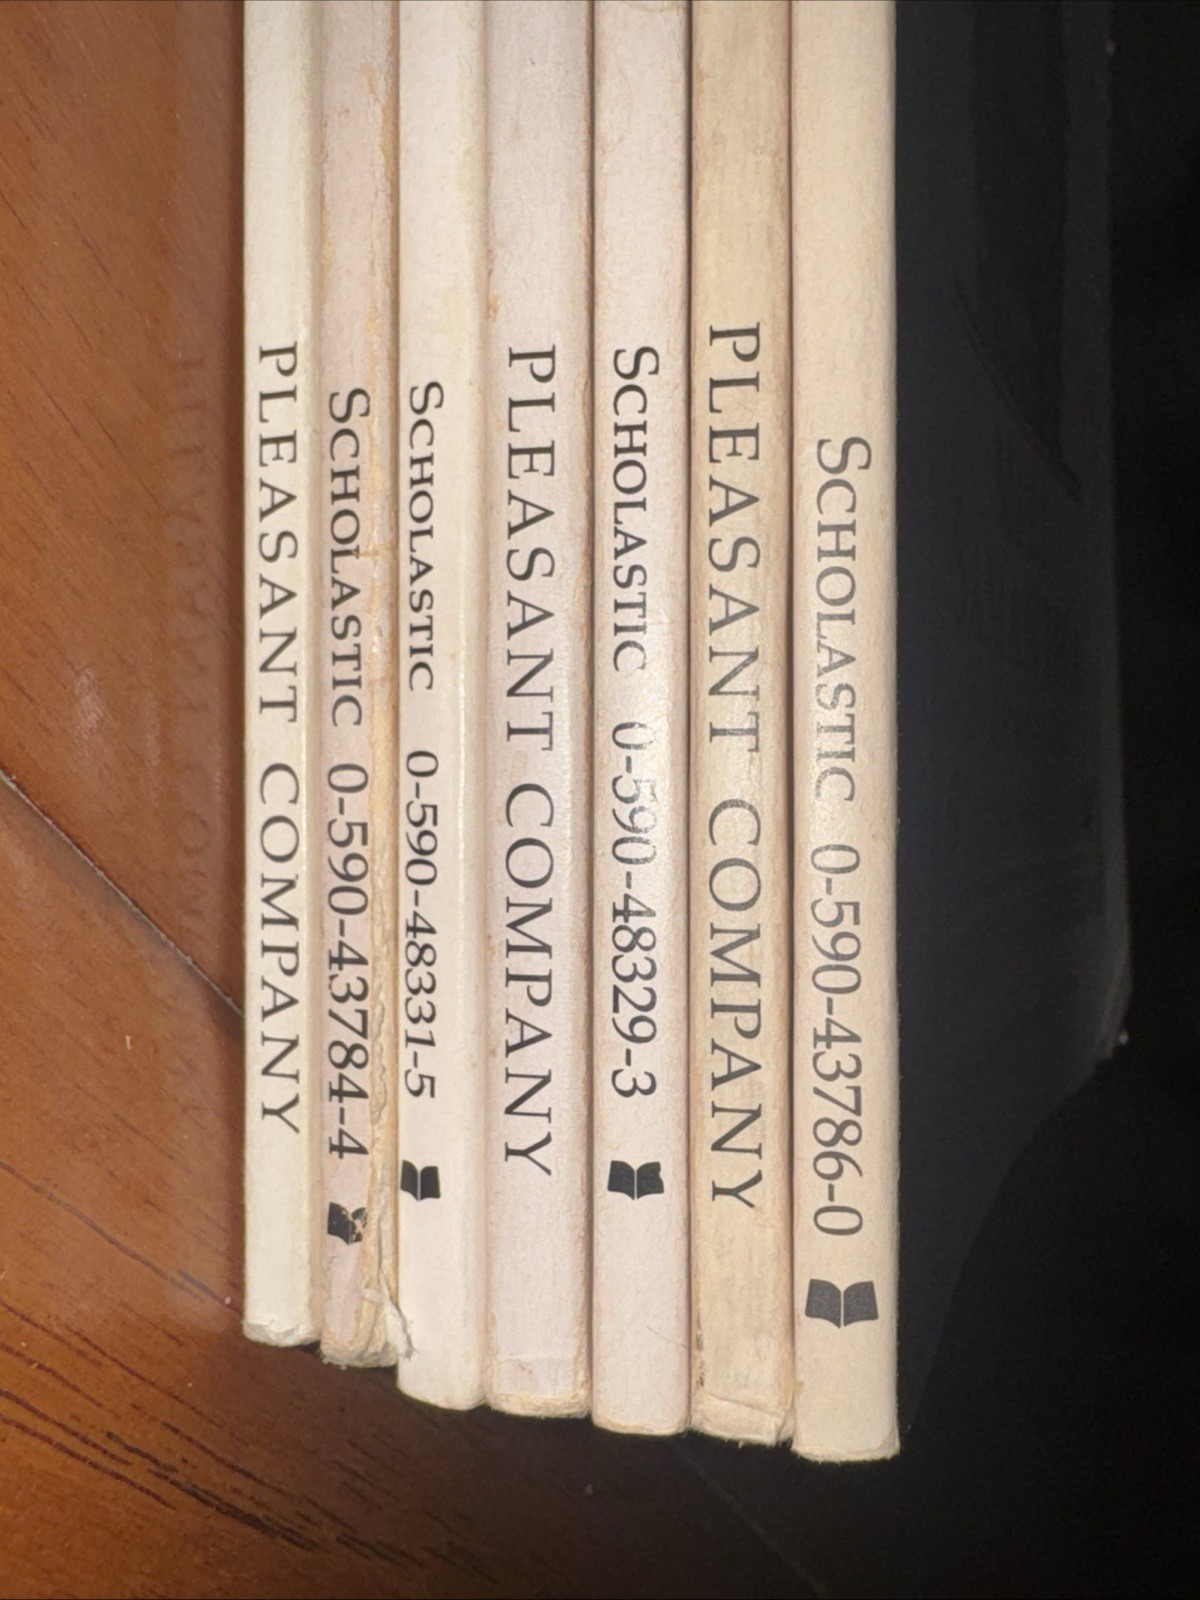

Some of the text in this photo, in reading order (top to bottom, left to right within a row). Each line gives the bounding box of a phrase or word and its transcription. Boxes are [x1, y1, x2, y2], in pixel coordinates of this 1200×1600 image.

[258, 342, 300, 1134] PLEASANT COMPANY
[327, 388, 371, 1159] SCHOLASTIC 0-590-43784-4
[404, 381, 444, 1098] SCHOLASTIC 0-590-48331-5
[504, 344, 556, 1176] PLEASANT COMPANY
[611, 346, 660, 1098] SCHOLASTIC 0-590-48329-3
[708, 322, 763, 1209] PLEASANT COMPANY
[811, 437, 872, 1236] SCHOLASTIC 0-590-43786-0
